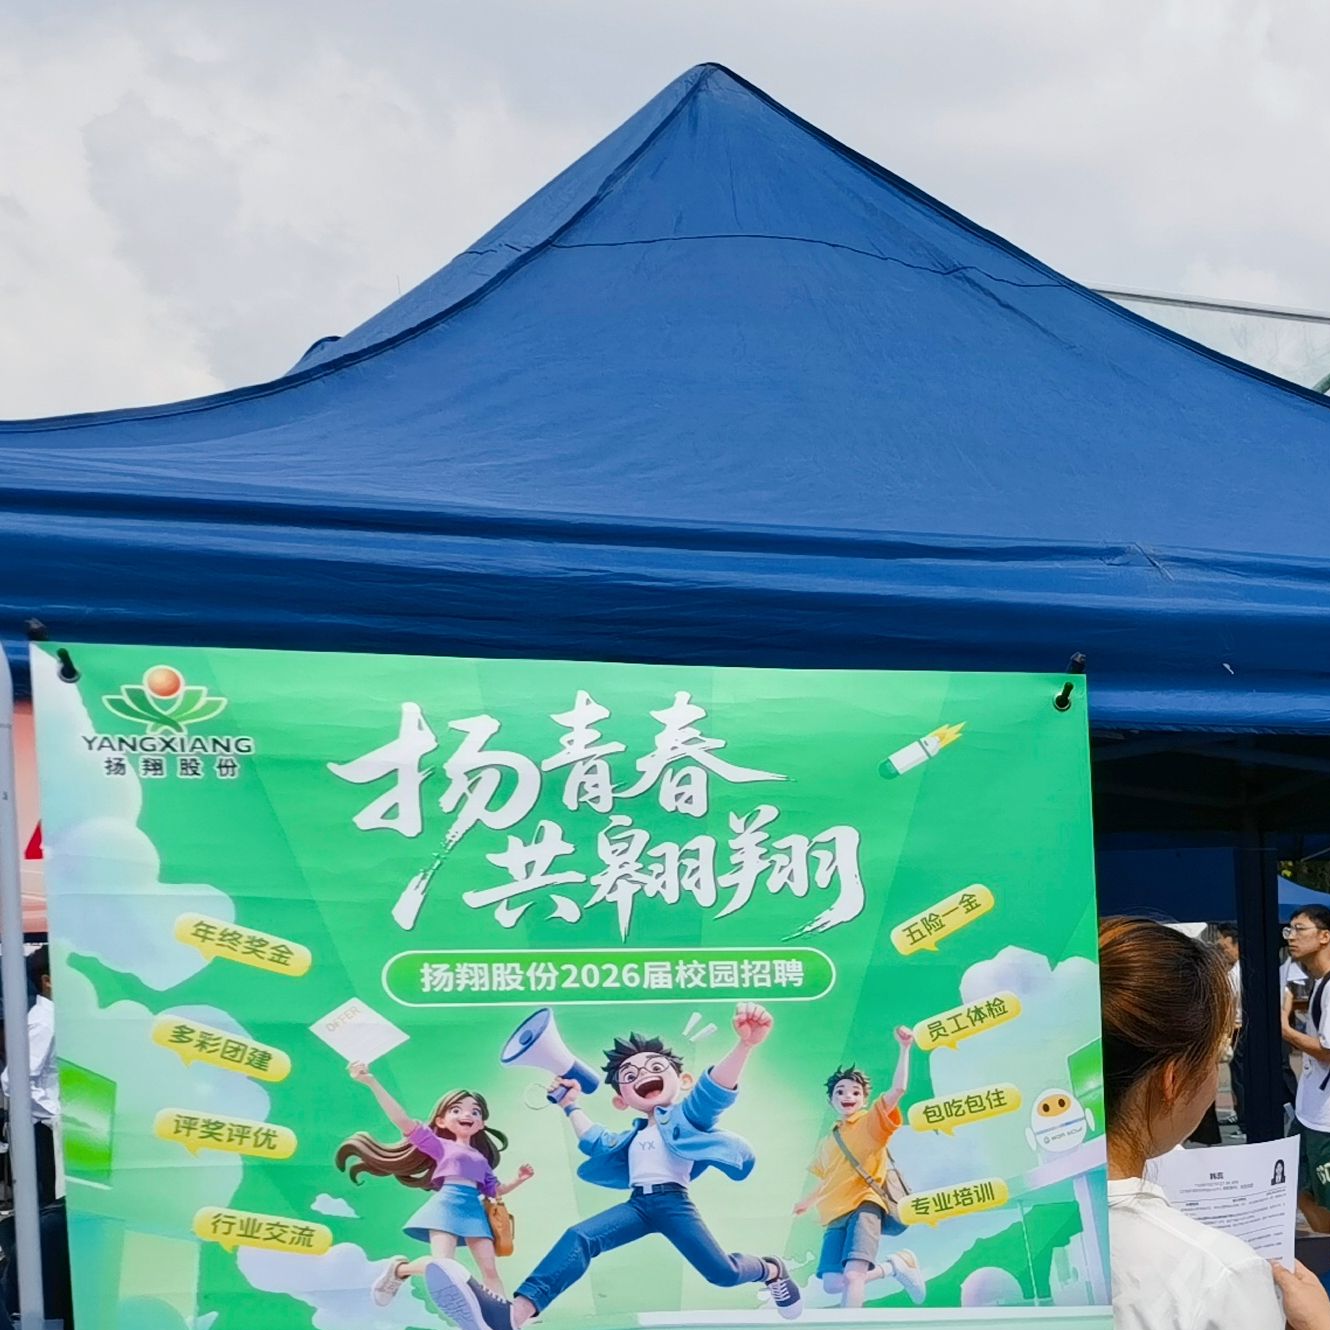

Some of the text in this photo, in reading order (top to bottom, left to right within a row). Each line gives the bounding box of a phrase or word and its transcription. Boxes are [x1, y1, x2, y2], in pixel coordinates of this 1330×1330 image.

[81, 735, 253, 755] YANGXIANG
[104, 757, 240, 778] 扬翔股份
[327, 690, 797, 930] 扬青春
[903, 891, 982, 946] 五险一金
[192, 919, 294, 968] 年终奖金
[420, 959, 805, 993] 扬翔股份2026届校园招聘
[925, 997, 1008, 1042] 员工体检
[169, 1024, 274, 1073] 多彩团建
[923, 1088, 1006, 1125] 包吃包住
[173, 1113, 278, 1151] 评奖评优
[910, 1181, 995, 1217] 专业培训
[210, 1212, 315, 1247] 行业交流
